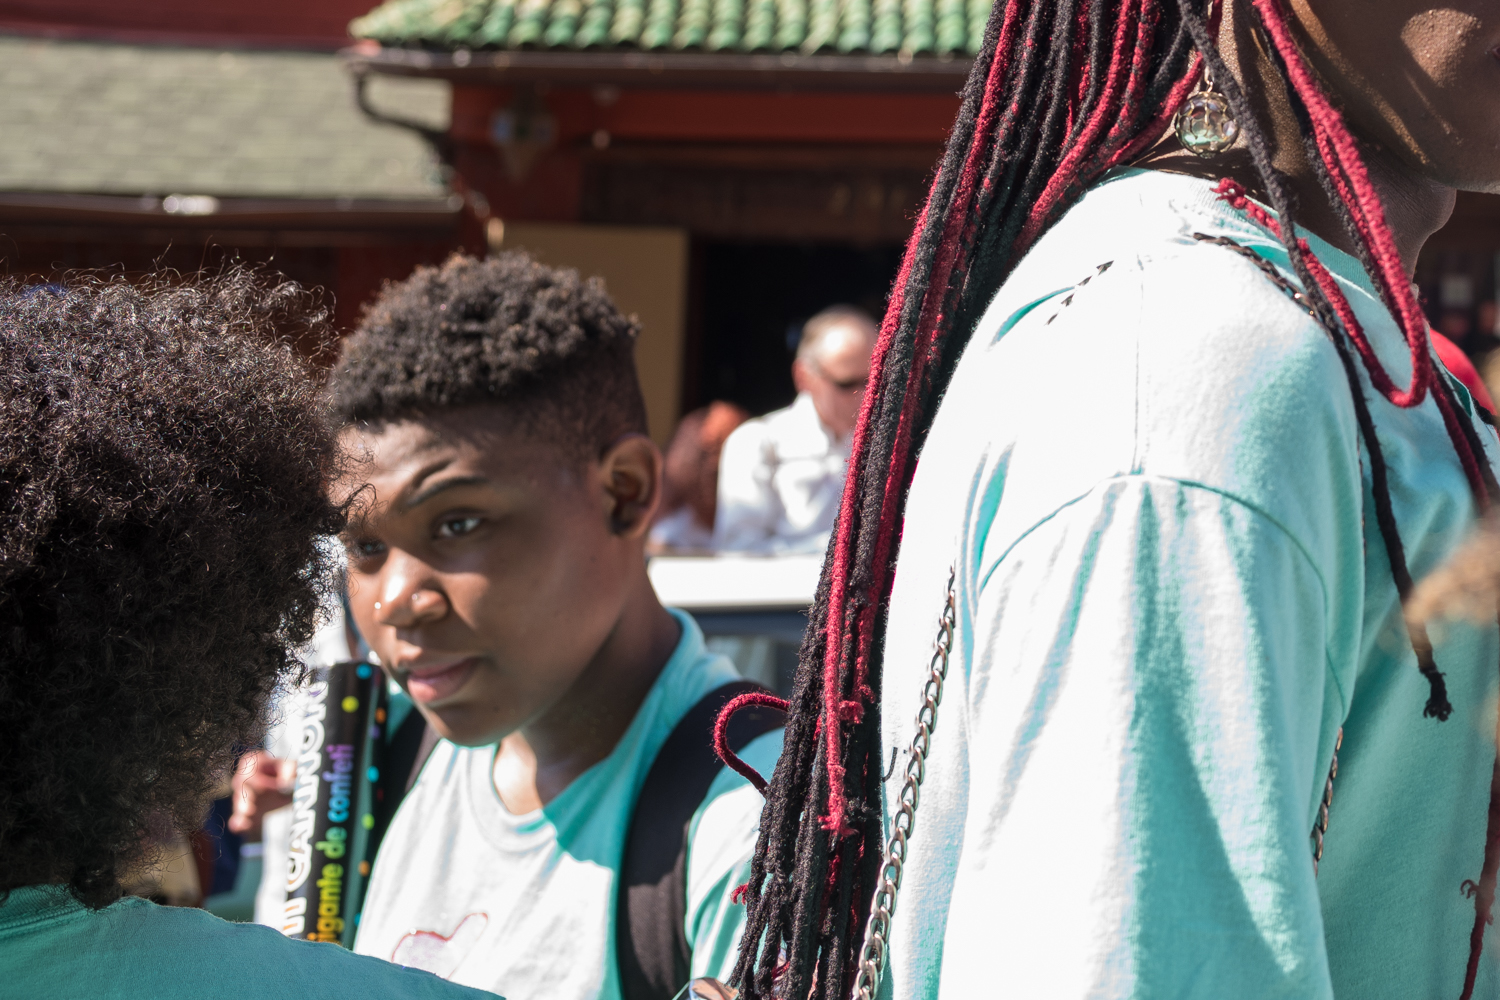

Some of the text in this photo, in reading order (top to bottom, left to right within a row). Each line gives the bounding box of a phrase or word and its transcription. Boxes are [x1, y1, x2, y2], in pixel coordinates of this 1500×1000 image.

[307, 744, 354, 945] igante de confeti
